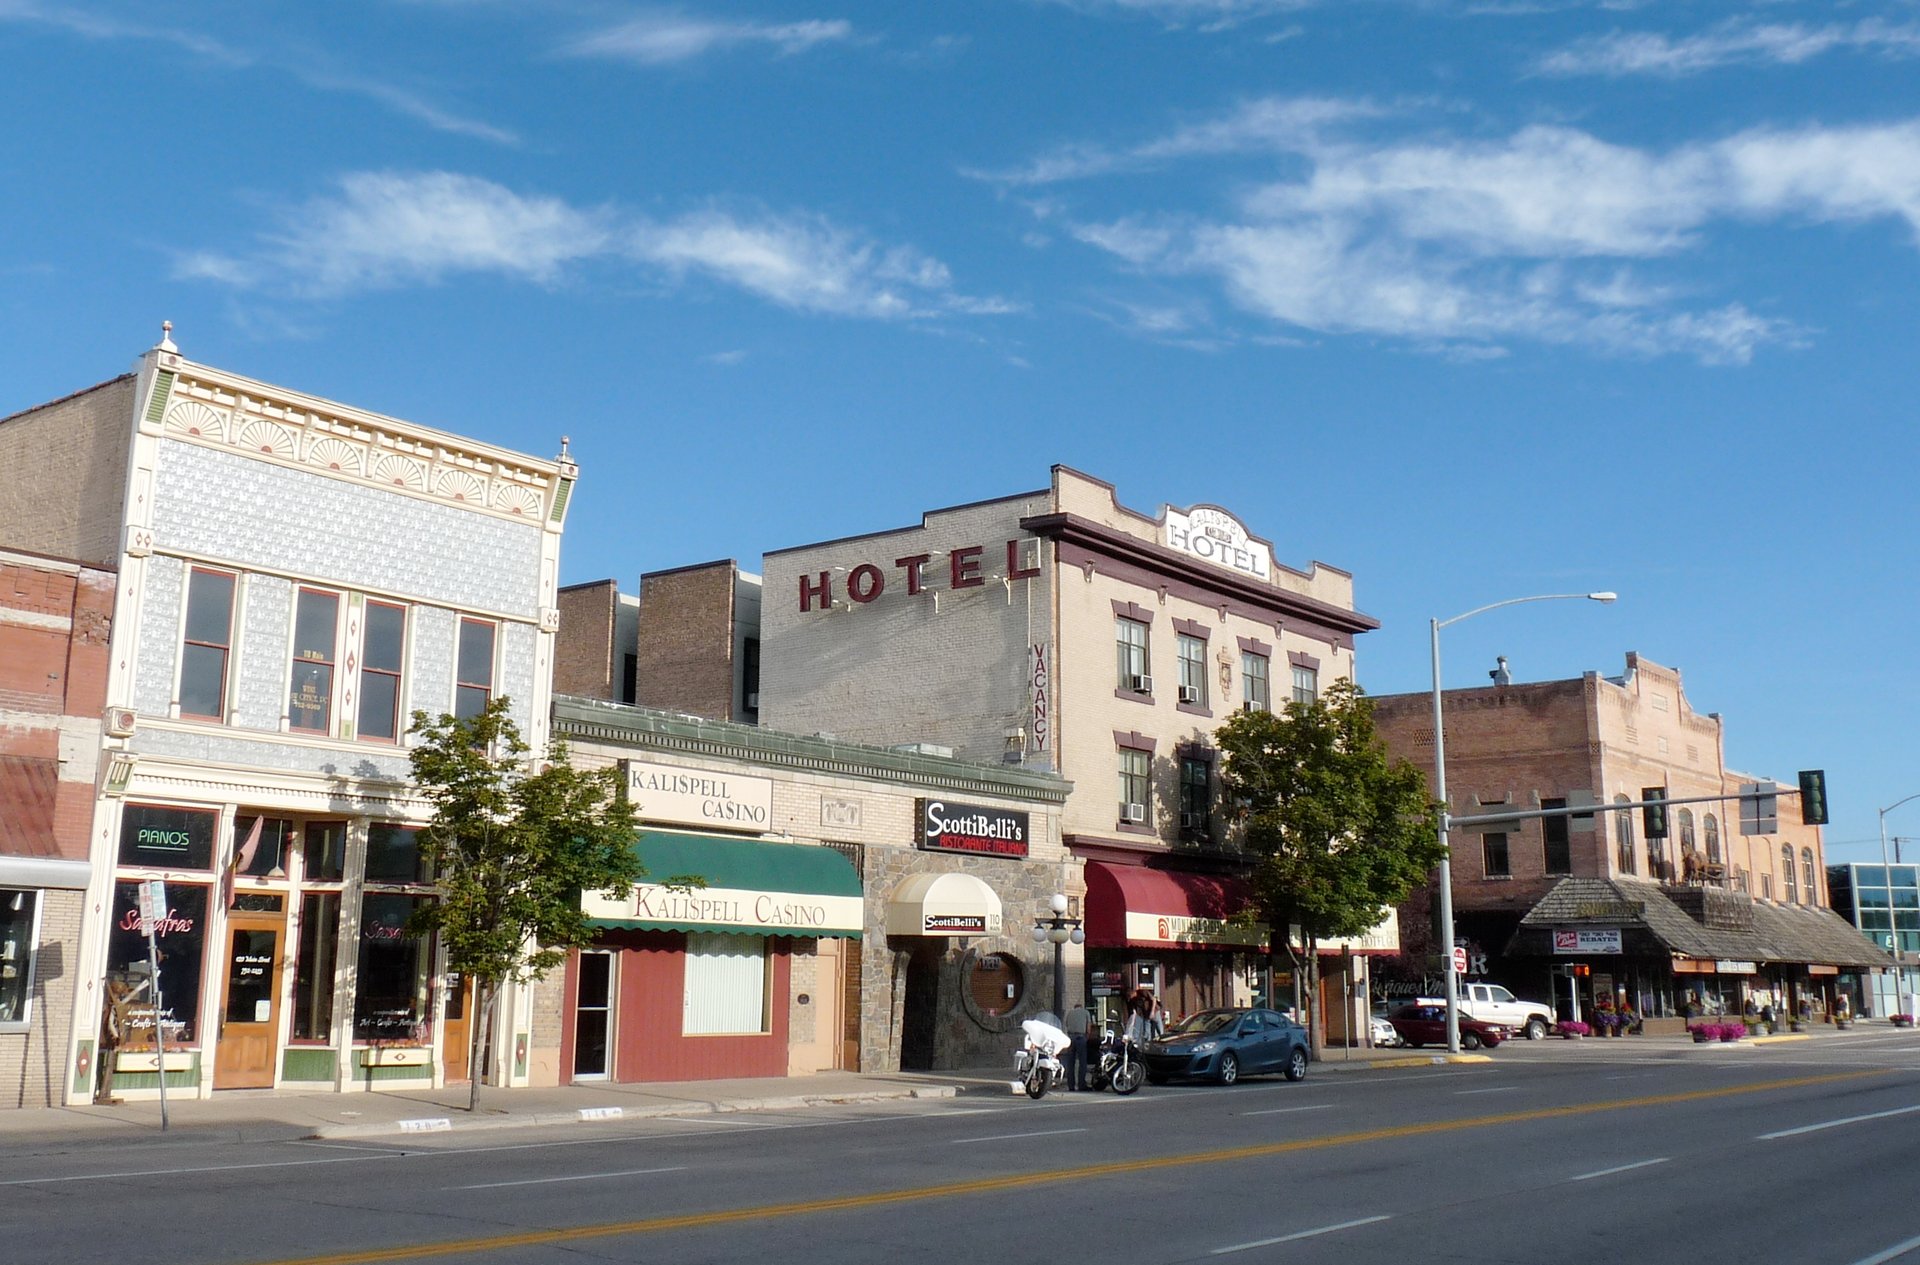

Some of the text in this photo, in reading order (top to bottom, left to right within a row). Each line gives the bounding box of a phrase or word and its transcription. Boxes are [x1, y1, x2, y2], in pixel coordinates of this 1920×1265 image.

[1169, 523, 1265, 577] HOTEL
[799, 539, 1041, 612] HOTEL
[1033, 643, 1047, 751] VACANCY
[926, 802, 1022, 841] ScottiBelli's
[138, 829, 190, 846] PIANOS
[940, 835, 992, 851] RISTORANTE
[119, 908, 194, 938] Saafras
[925, 914, 982, 928] ScottiBelli's
[989, 913, 1000, 924] 110
